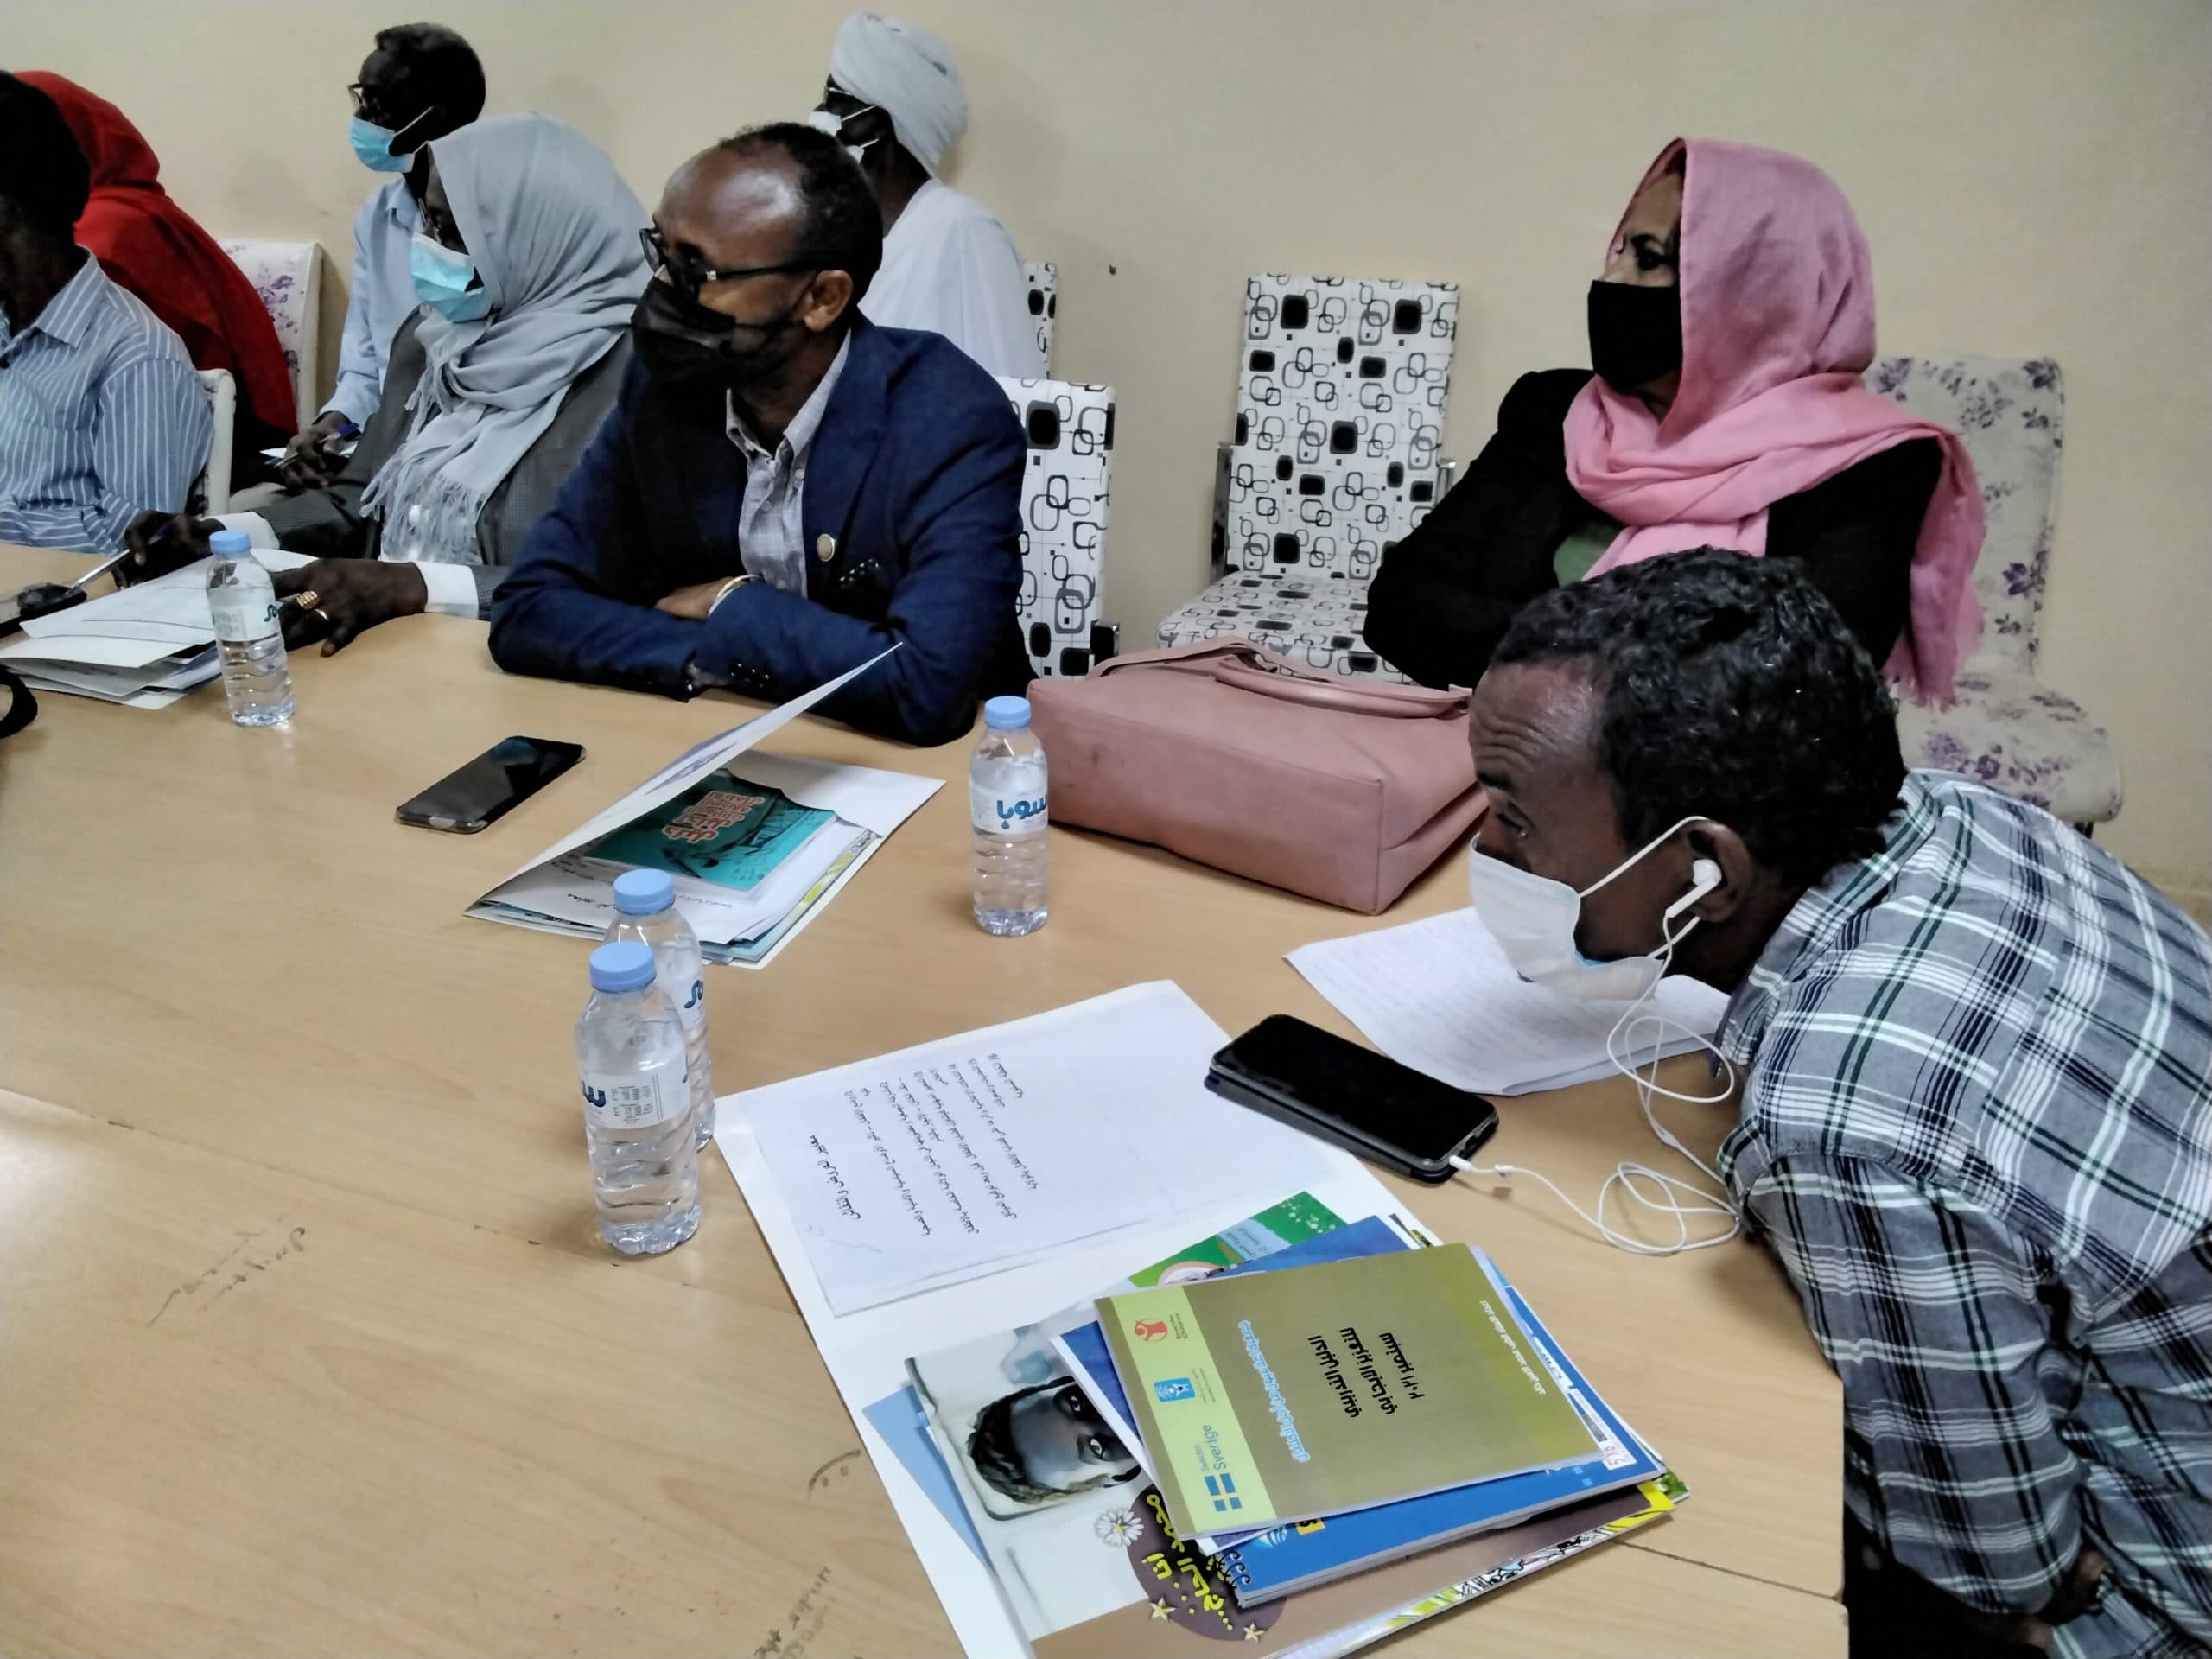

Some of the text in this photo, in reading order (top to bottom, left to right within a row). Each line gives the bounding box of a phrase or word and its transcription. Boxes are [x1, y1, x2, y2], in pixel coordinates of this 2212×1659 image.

[810, 1135, 861, 1219] معايير العروض والنقاش
[1339, 1327, 1373, 1364] للتعزيز
[1379, 1332, 1414, 1373] سبتمبر
[1512, 1350, 1527, 1368] محمد
[1308, 1336, 1362, 1417] الدليل التدريبي
[1203, 1424, 1226, 1470] Sverige
[1141, 1553, 1173, 1580] أنا
